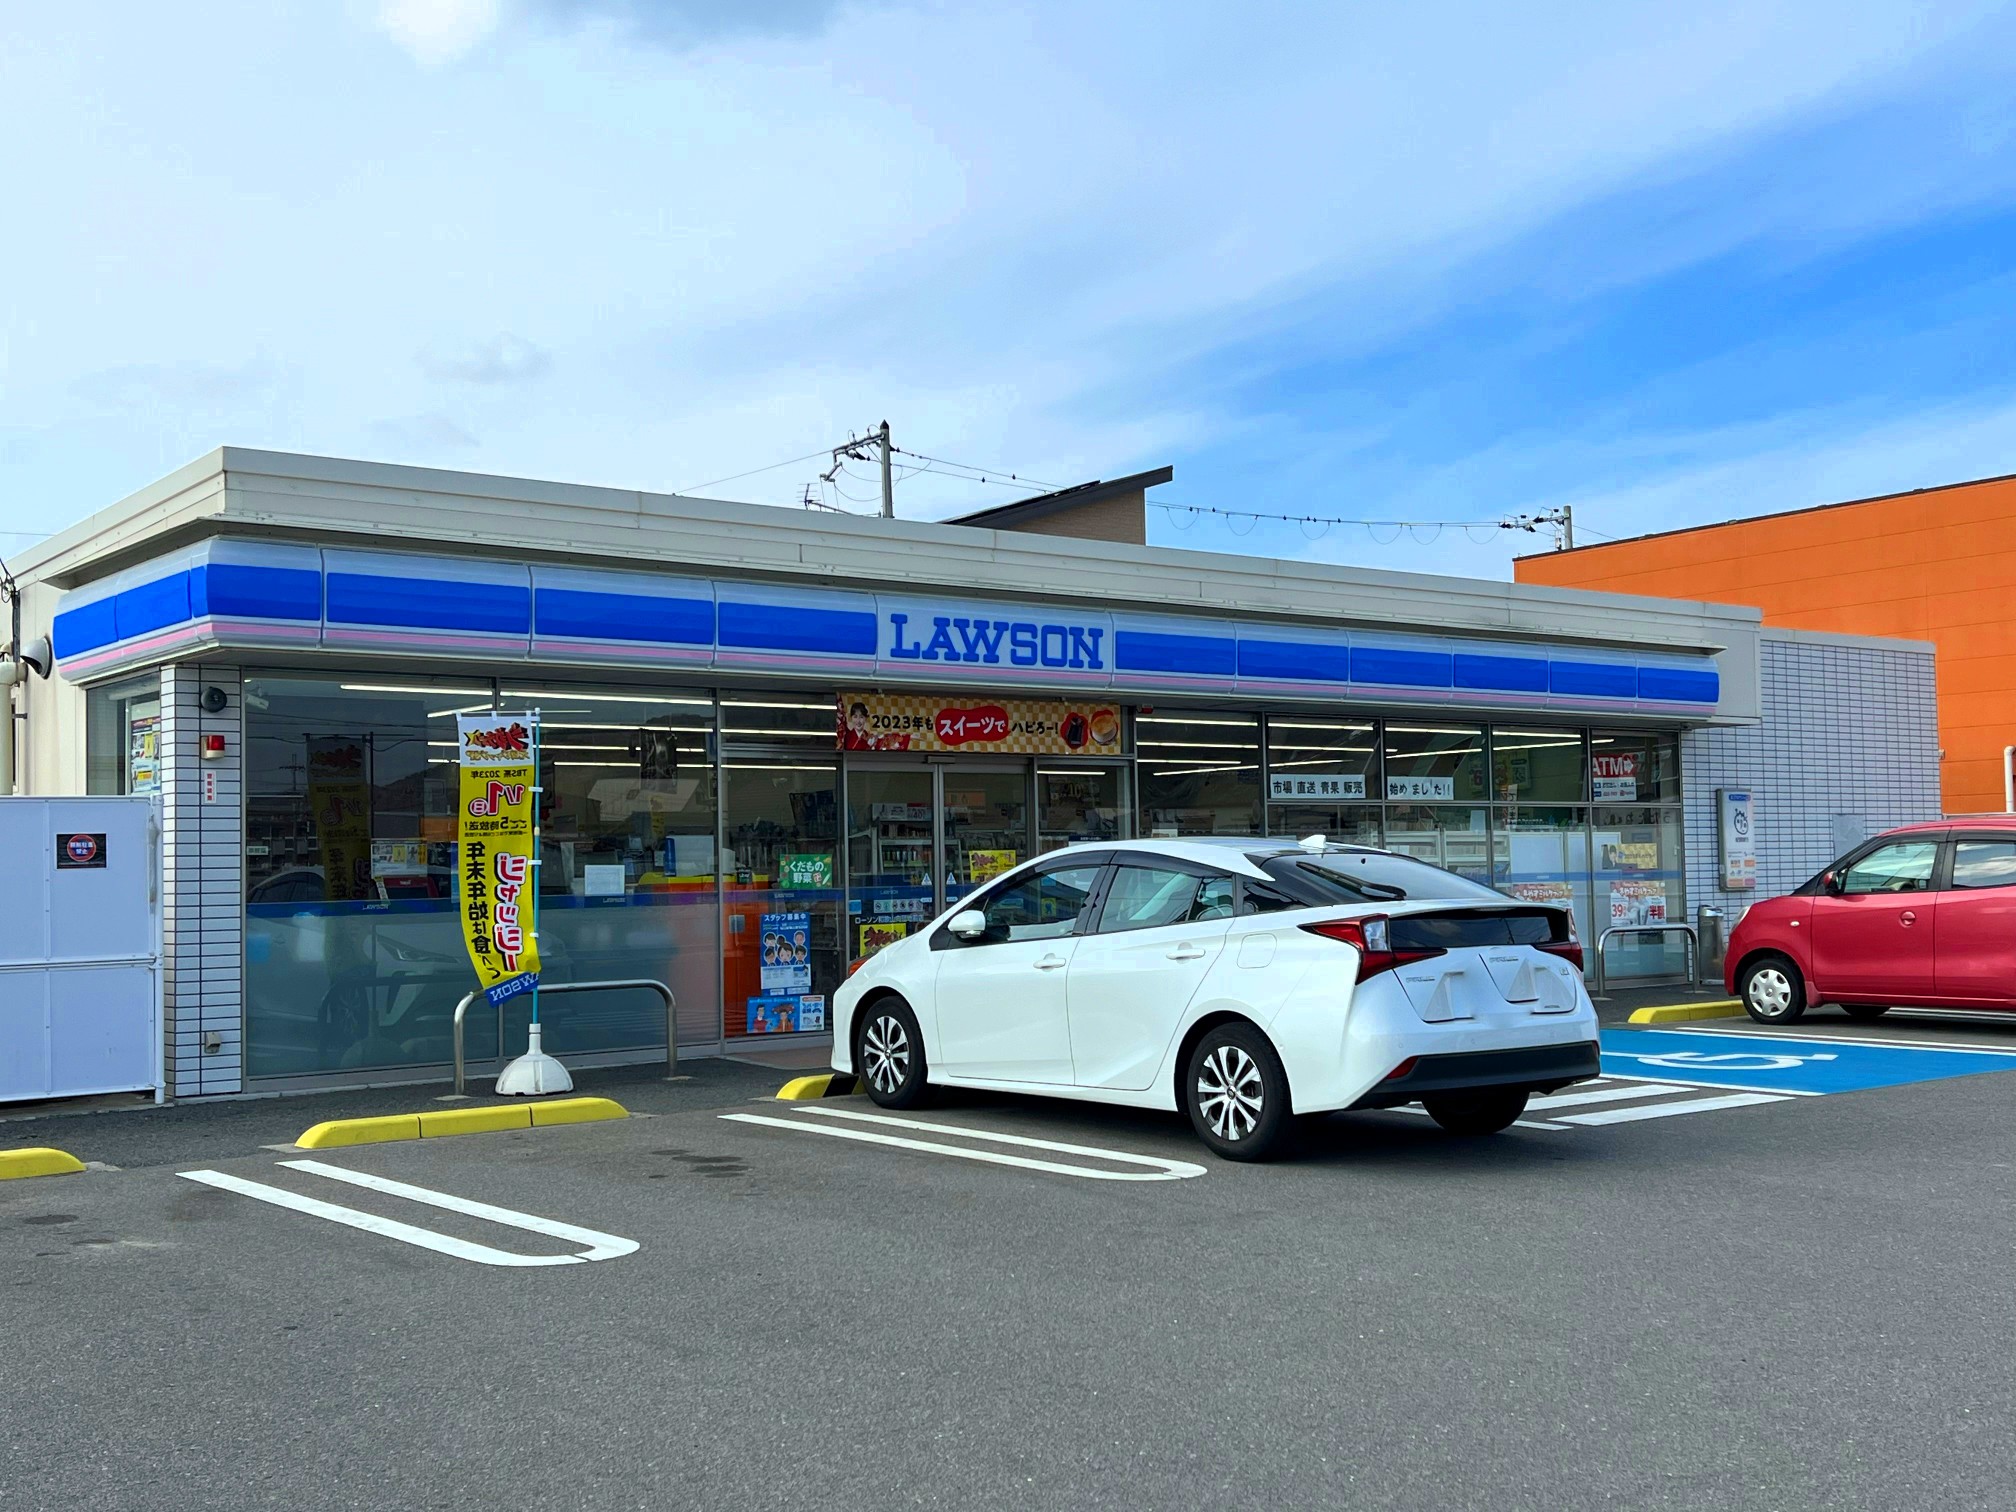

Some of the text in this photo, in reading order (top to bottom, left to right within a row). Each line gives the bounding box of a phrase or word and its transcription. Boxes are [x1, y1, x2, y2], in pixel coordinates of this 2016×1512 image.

[890, 613, 1103, 669] LAWSON
[872, 714, 933, 731] 2023年も
[939, 716, 1006, 737] スイーツで
[1592, 757, 1624, 776] ATM
[1272, 781, 1363, 794] 市場 直送 青果 販売
[1389, 783, 1408, 796] 始め
[789, 861, 824, 872] くだもの
[793, 872, 812, 884] 野菜
[764, 913, 806, 922] スタッフ募集中
[1649, 904, 1665, 919] 半額
